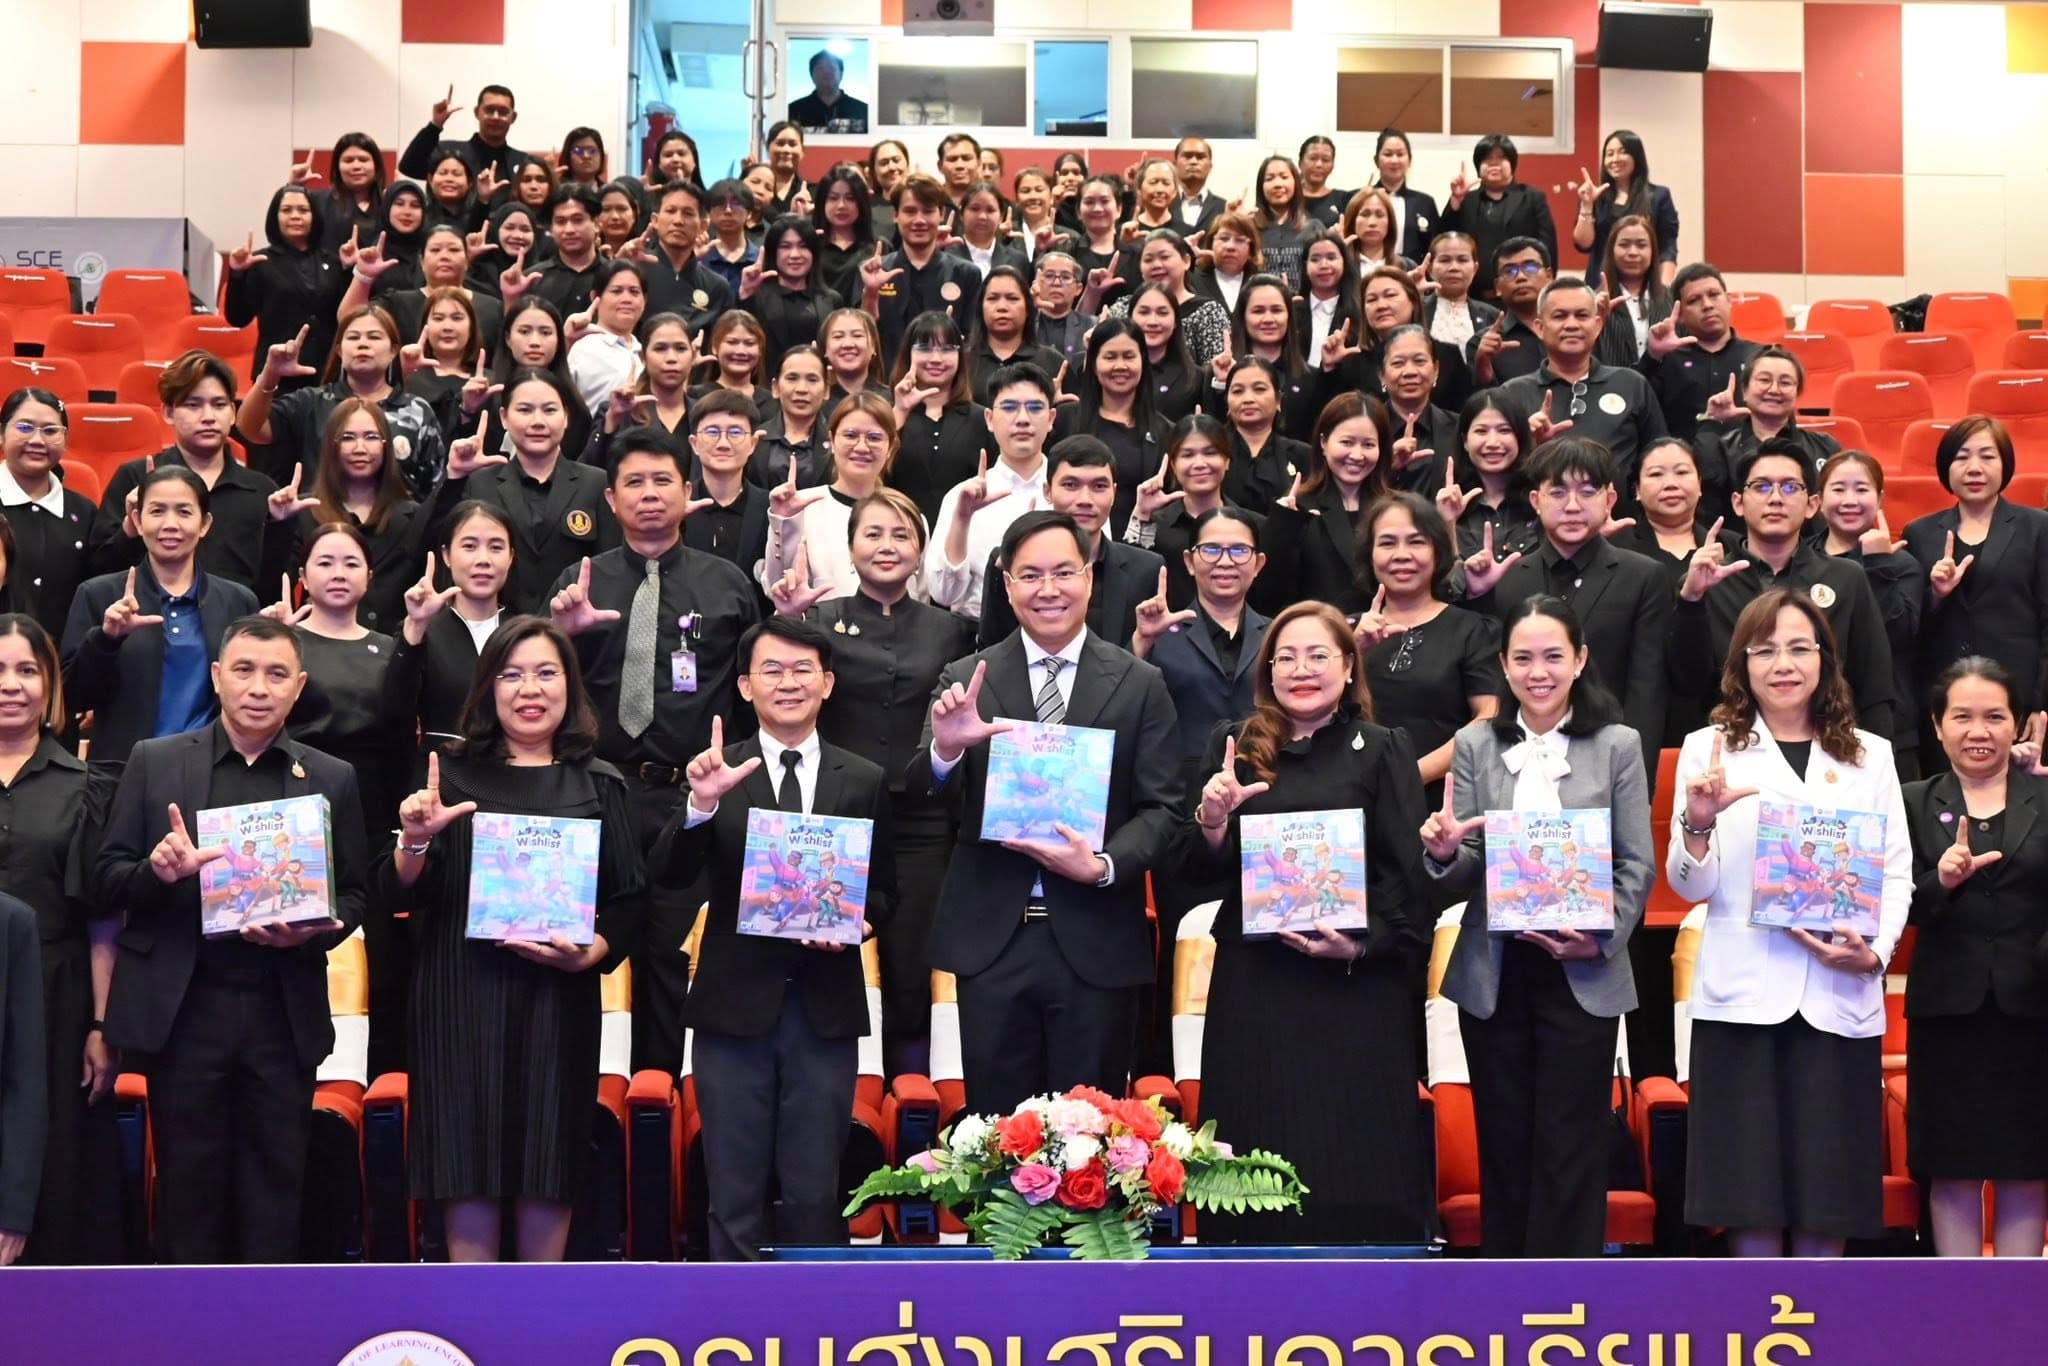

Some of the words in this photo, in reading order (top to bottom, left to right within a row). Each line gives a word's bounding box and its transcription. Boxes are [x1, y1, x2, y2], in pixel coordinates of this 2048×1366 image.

[16, 249, 63, 267] SCE
[240, 821, 284, 835] Wshlist
[1528, 828, 1572, 839] Wshlist
[1801, 827, 1847, 839] Wshlist
[516, 837, 561, 849] Wshlist
[788, 836, 833, 848] Wshlist
[358, 1351, 373, 1362] OF
[375, 1339, 431, 1353] LEARNING
